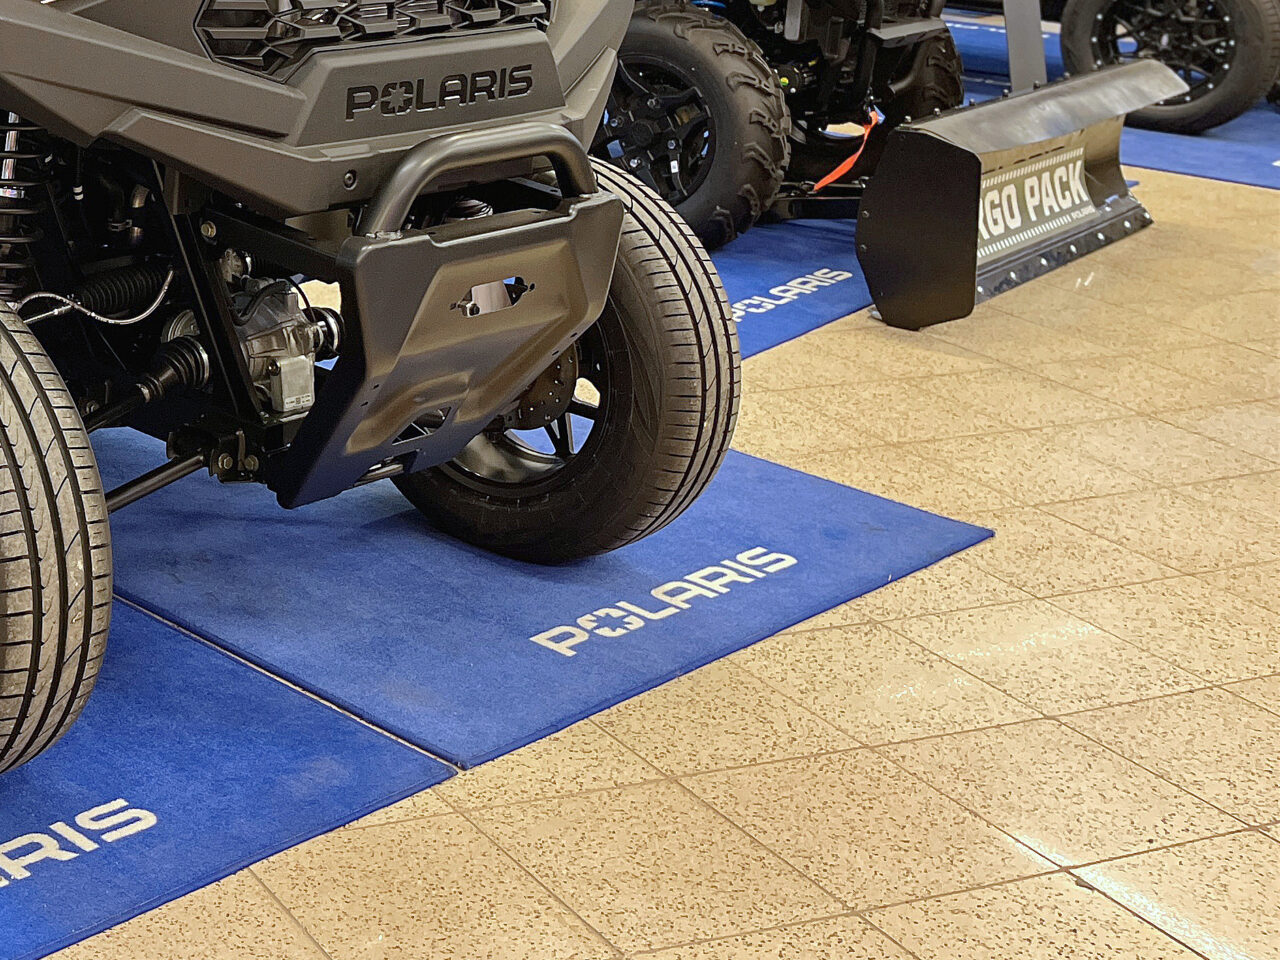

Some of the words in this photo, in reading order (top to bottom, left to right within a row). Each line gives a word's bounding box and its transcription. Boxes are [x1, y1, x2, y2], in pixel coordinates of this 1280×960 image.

[345, 63, 533, 122] POLARIS
[1024, 159, 1089, 222] PACK
[529, 546, 798, 657] POLARIS
